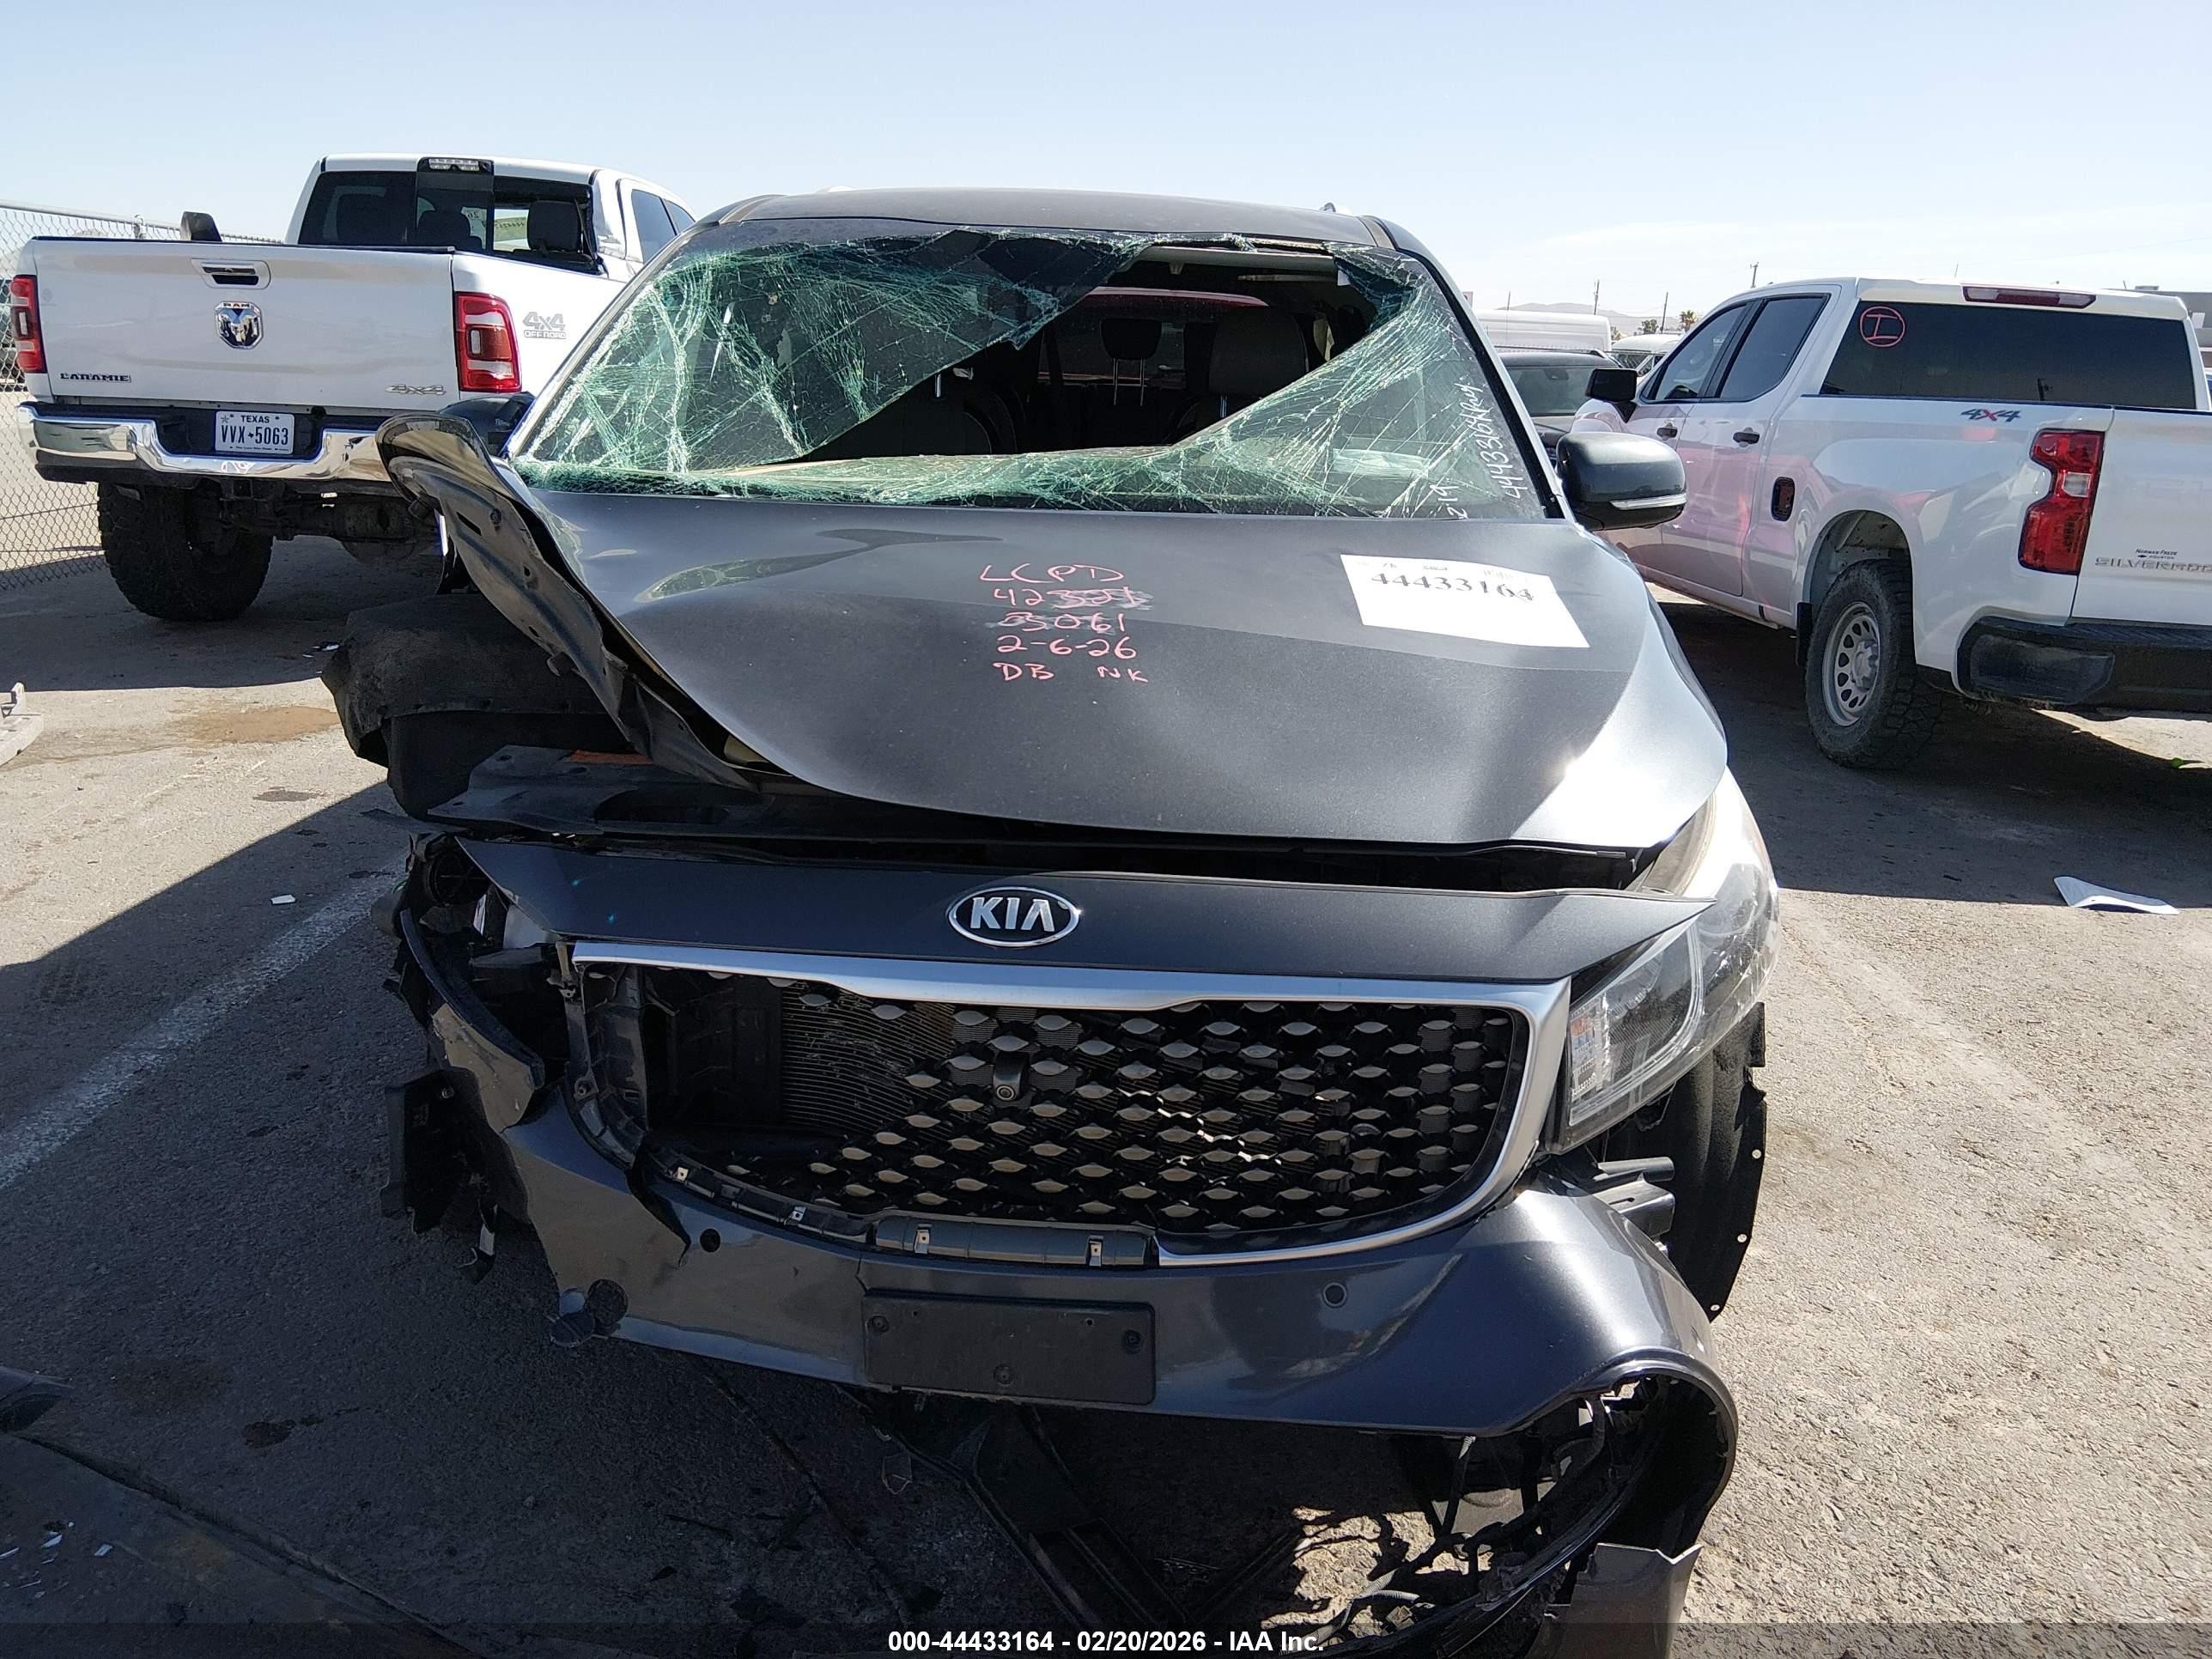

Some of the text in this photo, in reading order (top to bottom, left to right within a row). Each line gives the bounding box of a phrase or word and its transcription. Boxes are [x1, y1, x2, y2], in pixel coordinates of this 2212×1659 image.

[60, 373, 131, 383] LARAMIE
[240, 415, 270, 423] TEXAS
[997, 635, 1137, 659] 2-6-26
[970, 896, 1055, 933] KIA
